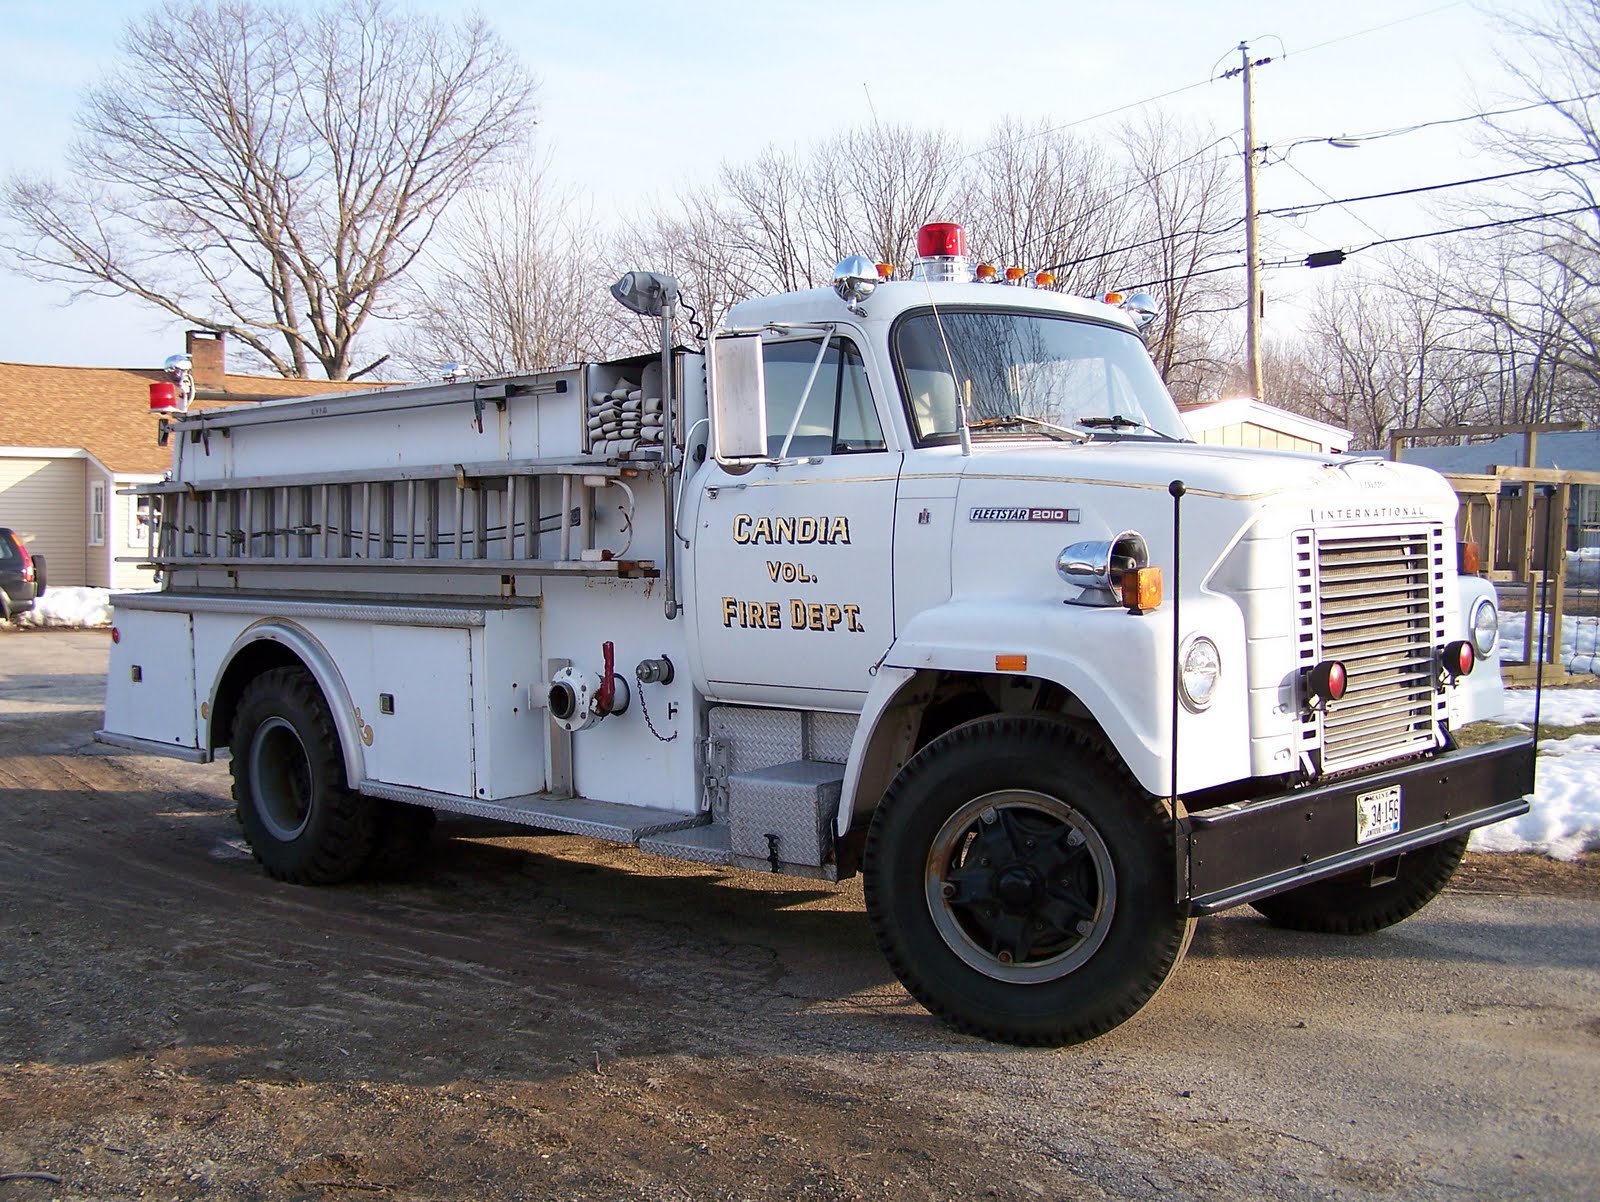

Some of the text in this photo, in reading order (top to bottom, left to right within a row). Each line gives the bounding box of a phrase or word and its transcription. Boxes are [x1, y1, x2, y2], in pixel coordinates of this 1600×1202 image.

[972, 508, 1064, 520] FLEETSTAR 2010
[1320, 506, 1424, 519] INTERNATIONAL
[733, 513, 851, 544] CANDIA
[766, 560, 818, 583] VOL.
[721, 596, 865, 633] FIRE DEPT.
